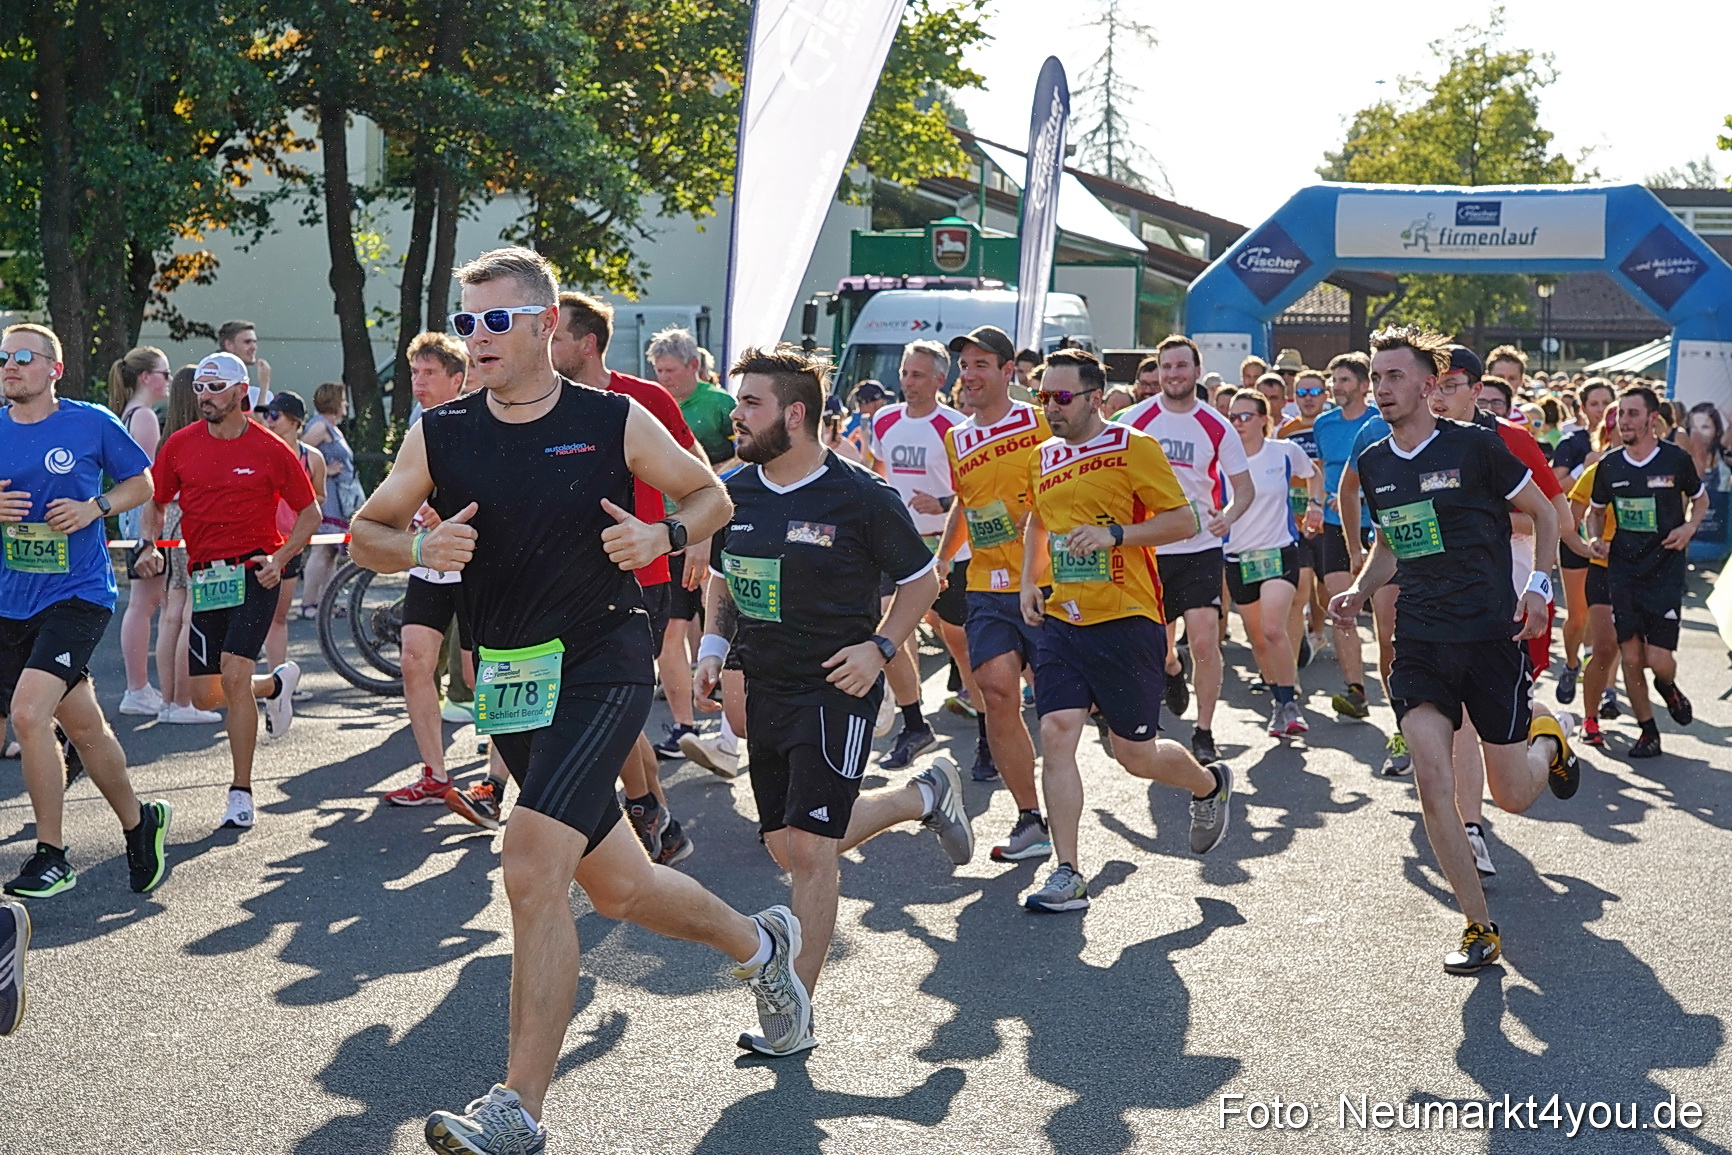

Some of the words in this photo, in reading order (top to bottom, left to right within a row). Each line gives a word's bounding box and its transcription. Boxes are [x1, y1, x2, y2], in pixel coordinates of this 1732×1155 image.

[1439, 227, 1538, 246] firmenlauf
[1246, 255, 1301, 269] Fischer
[545, 443, 587, 453] autoladen
[556, 445, 596, 456] neumarkt
[959, 451, 990, 477] MAX
[994, 435, 1042, 457] BÖGL
[1039, 469, 1073, 494] MAX
[1079, 457, 1127, 475] BÖGL
[1394, 522, 1423, 542] 425
[1428, 521, 1440, 546] 2022
[13, 539, 57, 557] 1754
[58, 542, 66, 566] 2022
[1099, 552, 1107, 575] 2022
[201, 580, 238, 597] 1705
[734, 576, 762, 600] 426
[768, 584, 776, 613] 2022
[494, 681, 539, 708] 778
[545, 683, 556, 717] 2022
[479, 693, 487, 720] RUN
[489, 710, 520, 720] Schlierf
[522, 707, 544, 718] Bernd
